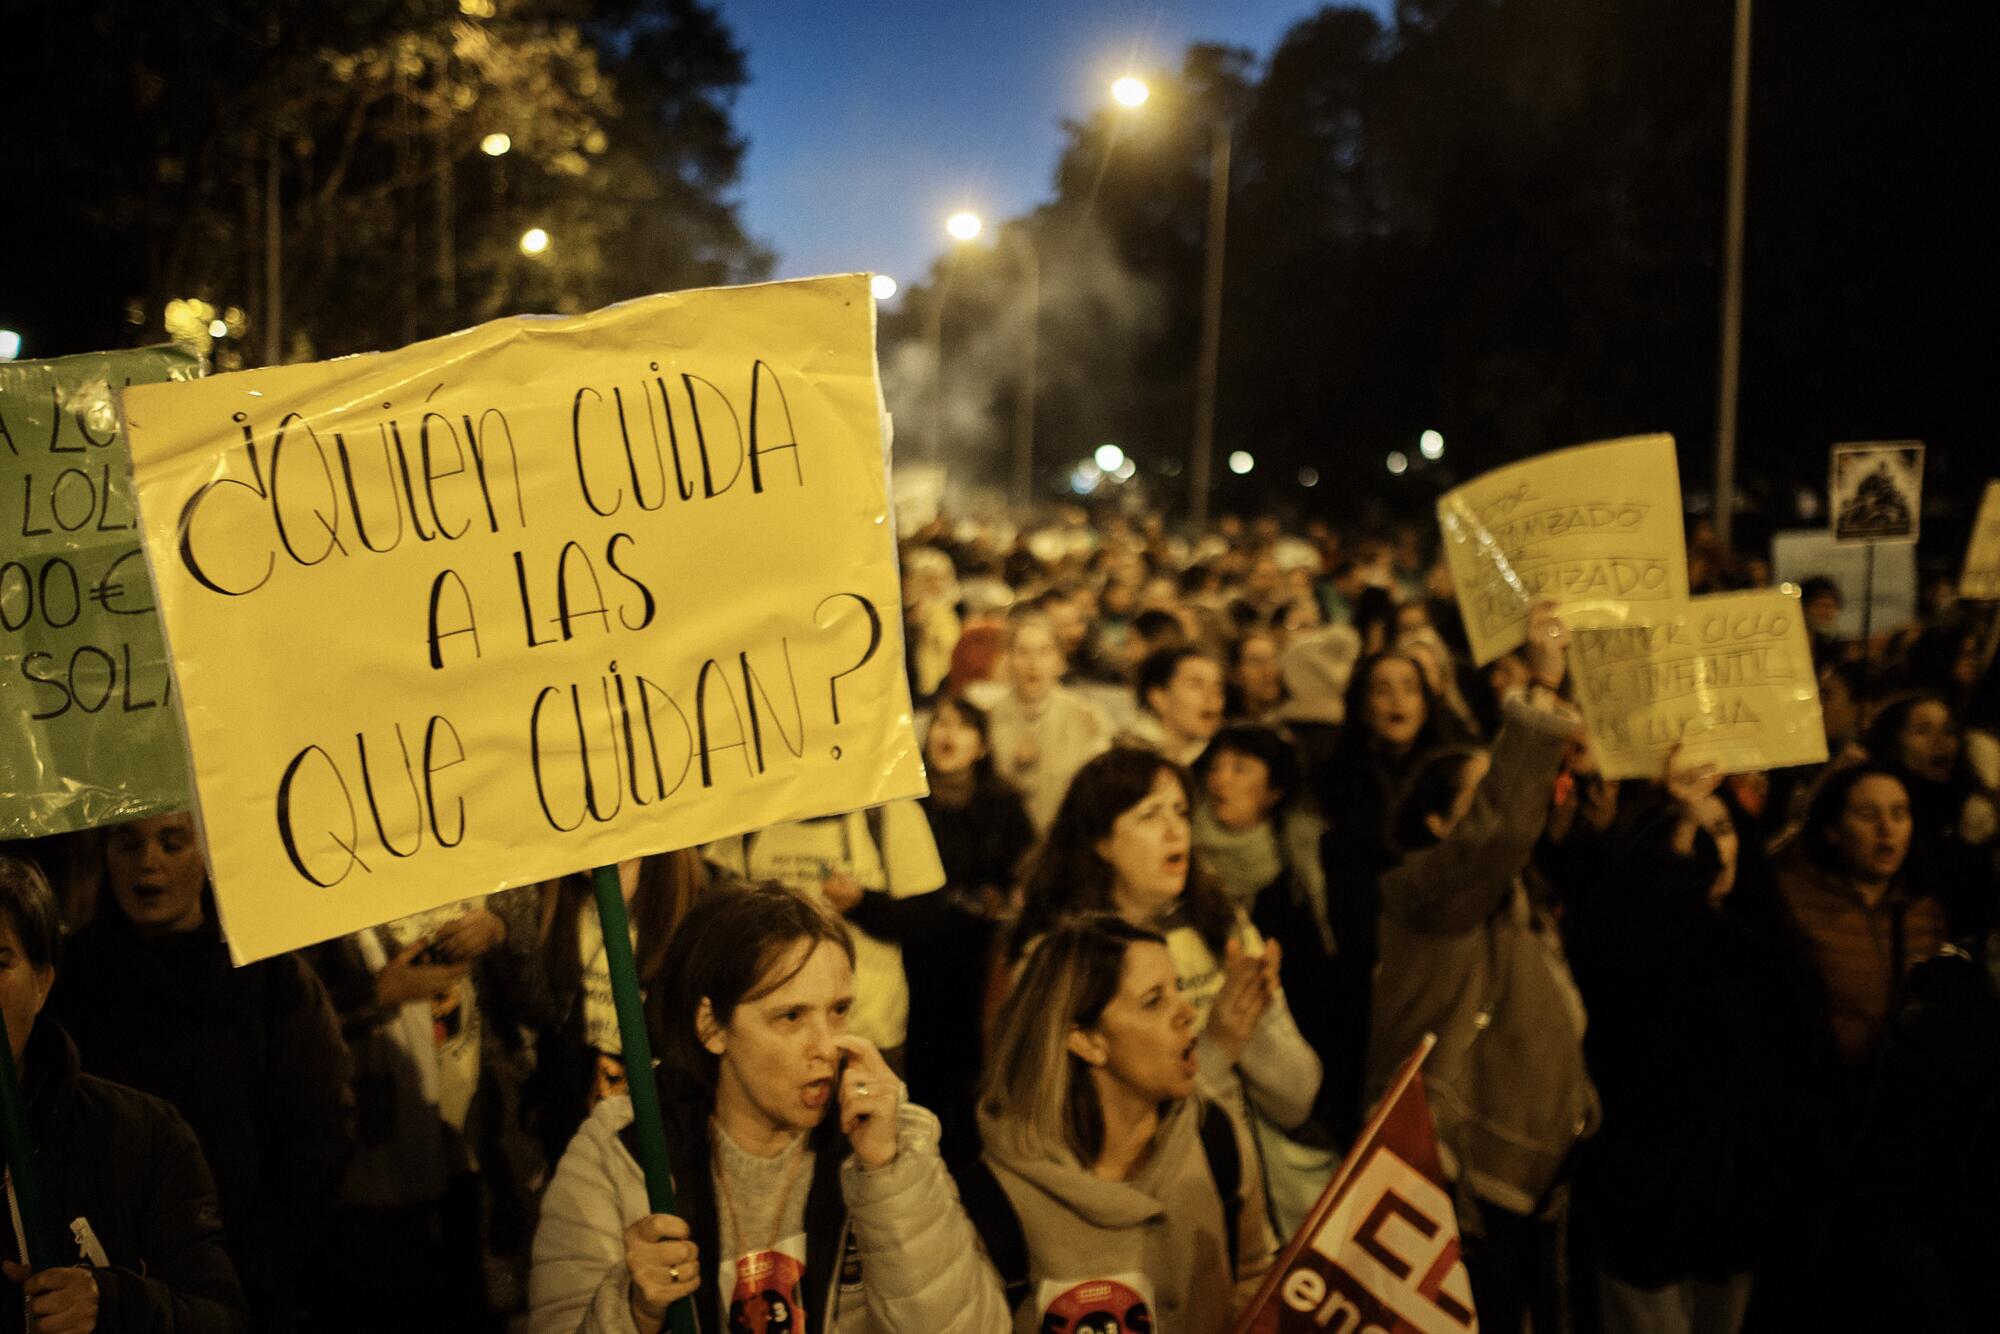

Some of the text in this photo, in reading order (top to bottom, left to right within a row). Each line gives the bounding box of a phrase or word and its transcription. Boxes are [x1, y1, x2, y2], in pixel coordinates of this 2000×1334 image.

[21, 462, 138, 537] LOL
[426, 532, 655, 670] A LAS
[20, 643, 171, 720] SOL
